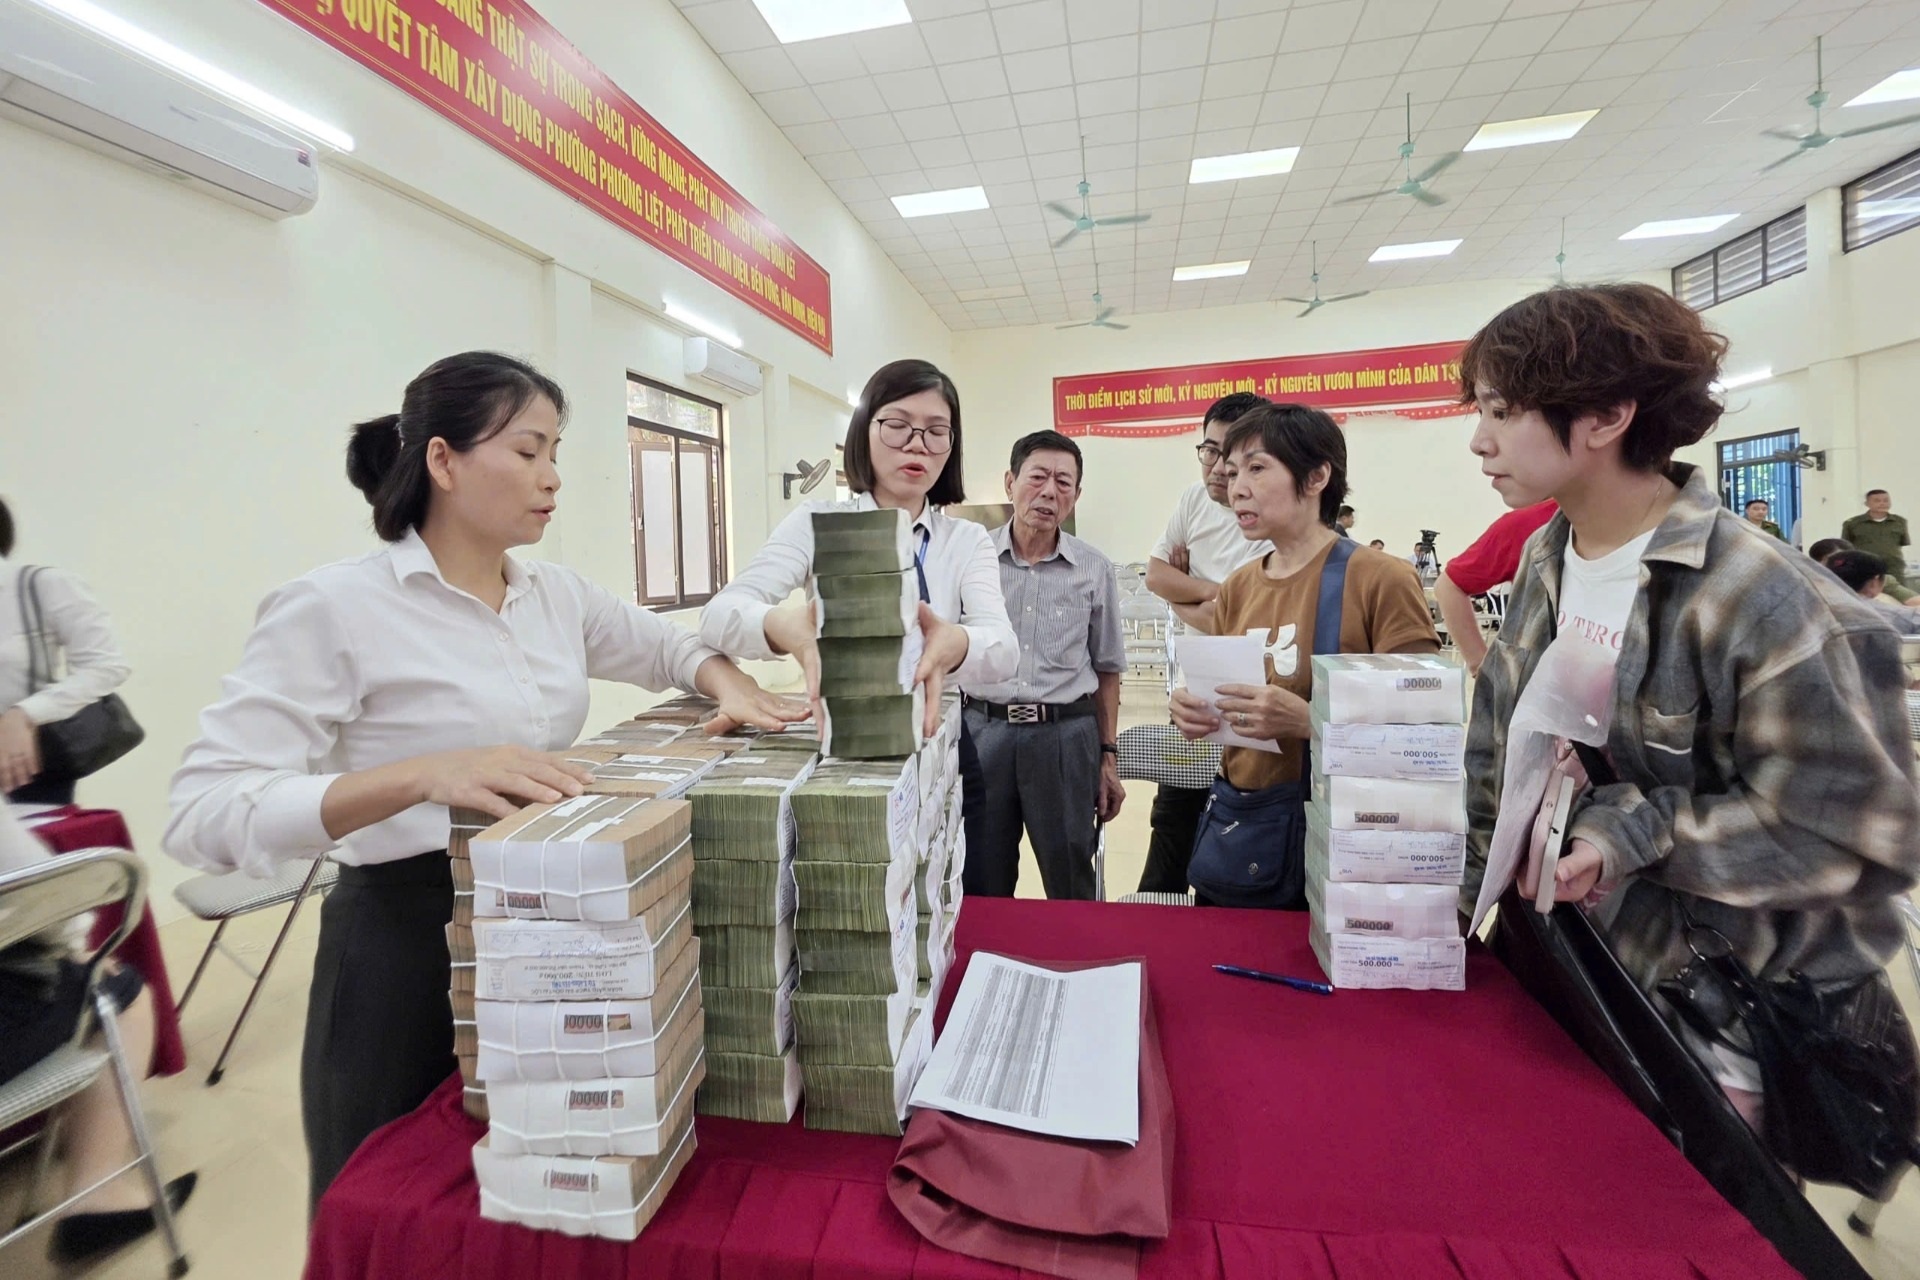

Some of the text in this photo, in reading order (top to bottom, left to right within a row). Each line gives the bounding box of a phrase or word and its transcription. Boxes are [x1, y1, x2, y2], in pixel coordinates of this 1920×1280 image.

[487, 2, 526, 71] THẬT
[530, 40, 549, 95] SỰ
[551, 59, 593, 123] TRONG
[595, 96, 628, 155] SẠCH,
[630, 123, 657, 173] VỮNG
[689, 172, 708, 213] PHÁT
[710, 190, 724, 225] HUY
[416, 22, 460, 92] TÂM
[464, 57, 497, 117] XÂY
[501, 85, 542, 149] DỰNG
[545, 117, 597, 186] PHƯỜNG
[599, 156, 643, 217] PHƯƠNG
[644, 189, 664, 234] LIỆT
[665, 204, 688, 246] PHÁT
[689, 221, 712, 263] TRIỂN
[1064, 391, 1086, 411] THỜI
[1088, 386, 1113, 409] ĐIỂM
[1114, 389, 1137, 410] LỊCH
[1138, 383, 1153, 405] SỬ
[1178, 379, 1192, 402] KỶ
[1193, 378, 1234, 400] NGUYÊN
[1264, 372, 1278, 395] KỶ
[1279, 372, 1321, 394] NGUYÊN
[1323, 370, 1353, 391] VƯƠN
[1355, 367, 1386, 388] MÌNH
[1388, 362, 1412, 386] CỦA
[1414, 362, 1439, 384] DÂN
[1403, 750, 1438, 758] 500.000
[1410, 854, 1444, 862] 500.000
